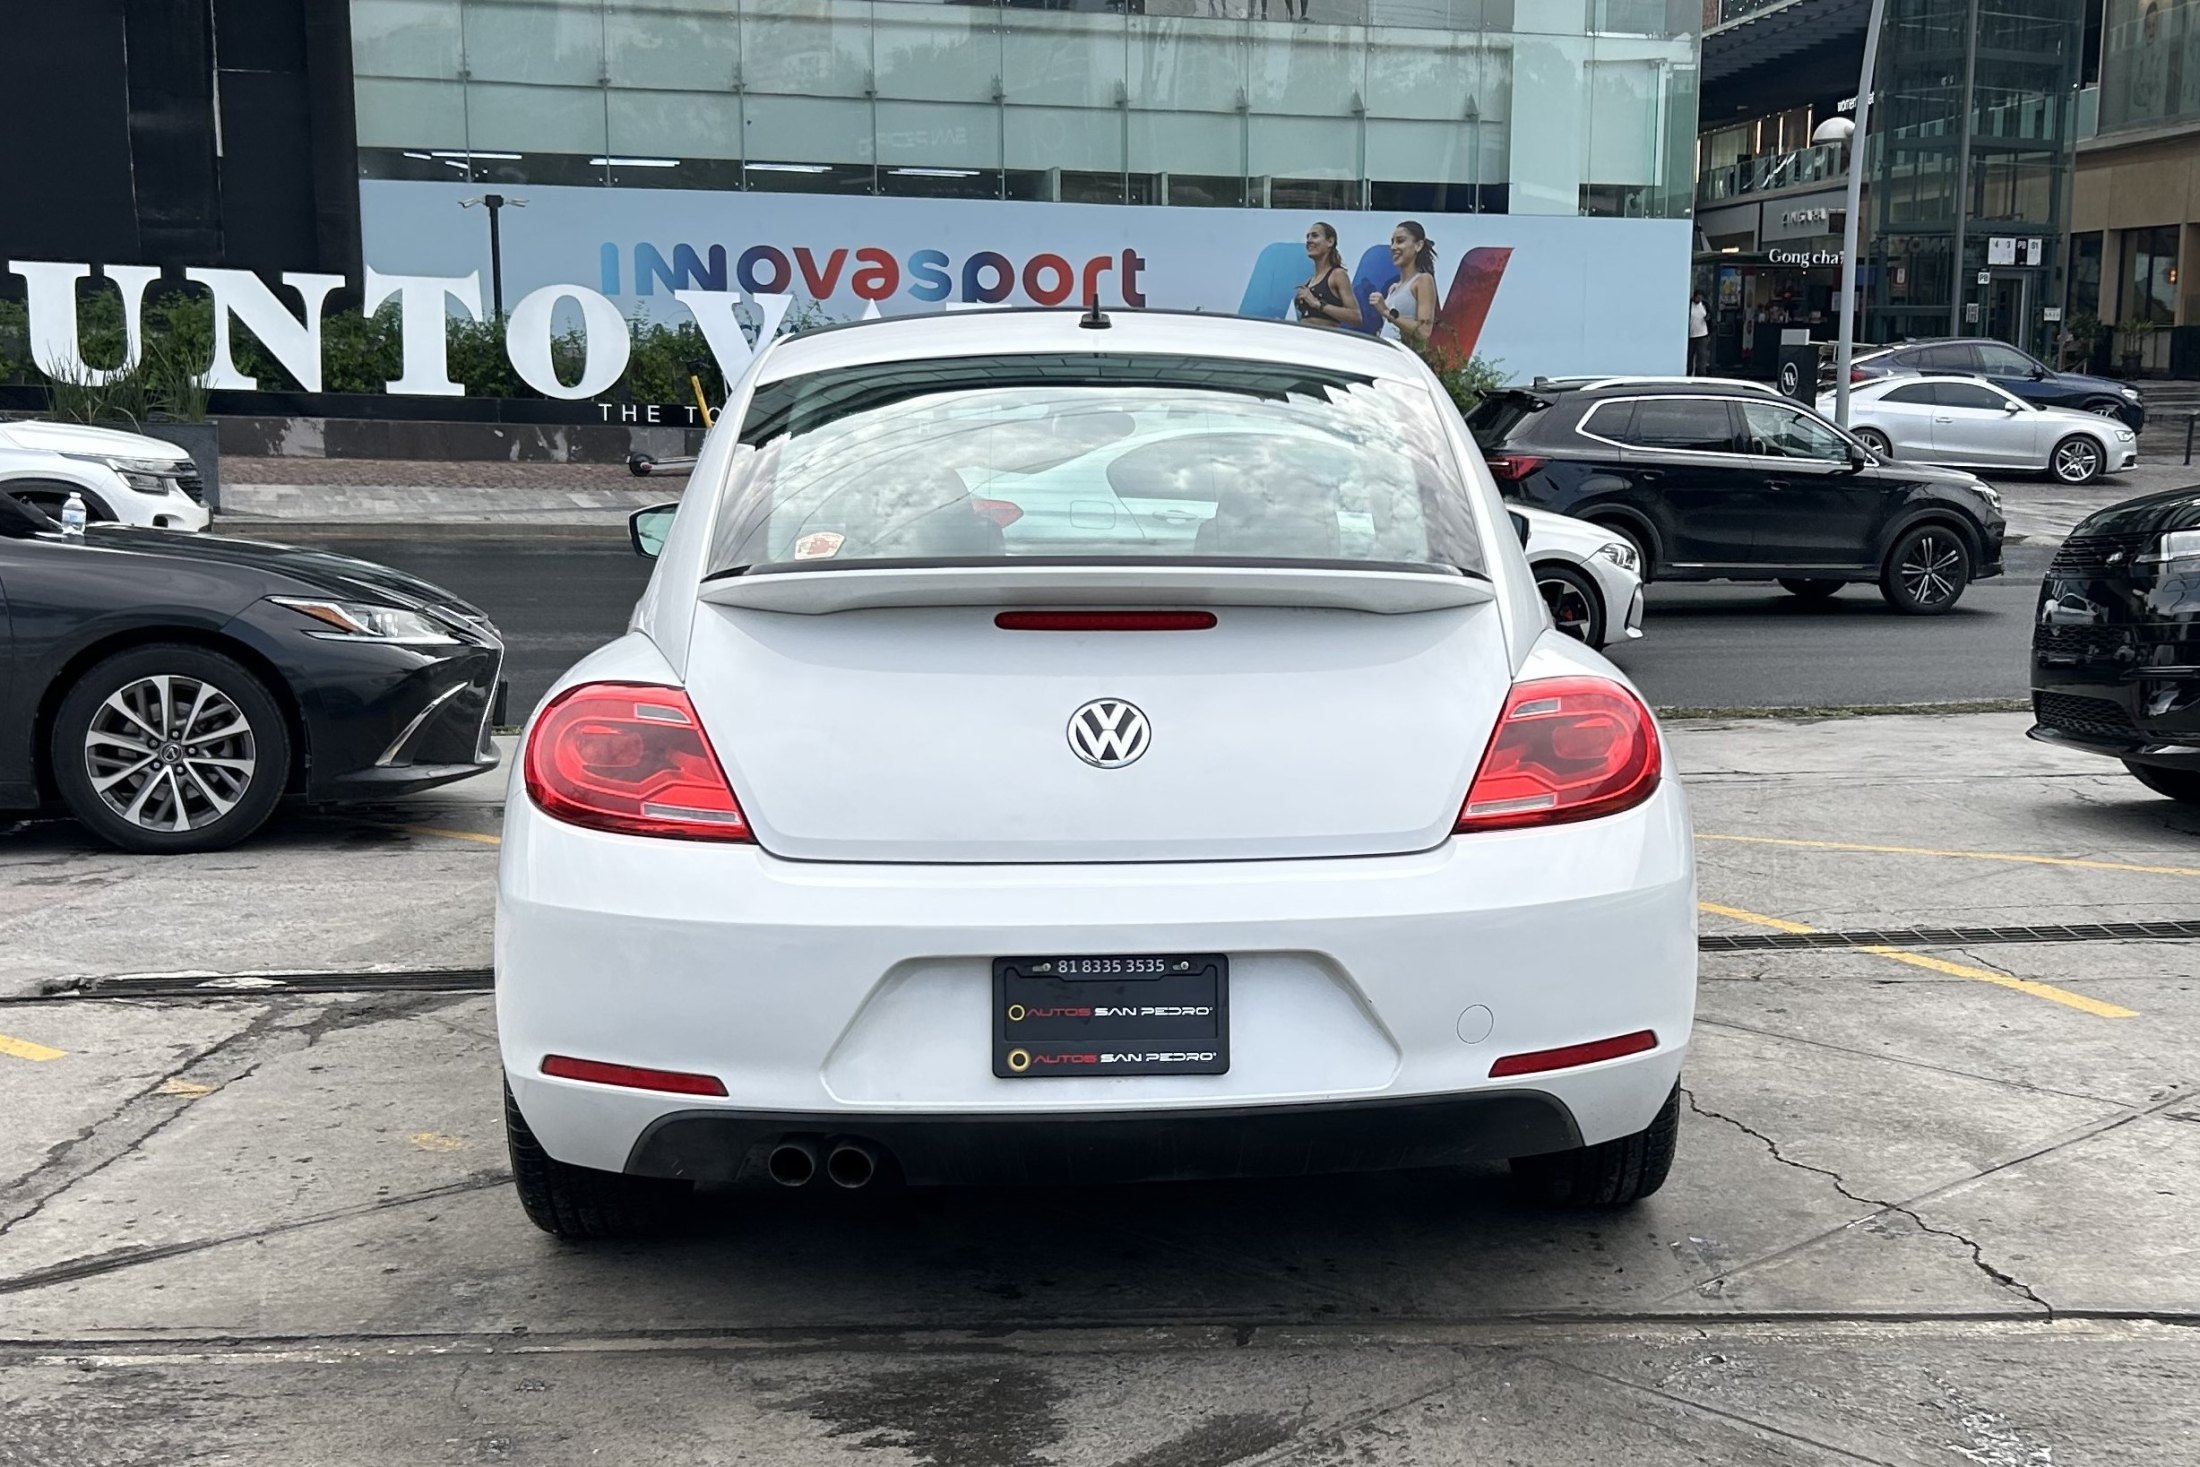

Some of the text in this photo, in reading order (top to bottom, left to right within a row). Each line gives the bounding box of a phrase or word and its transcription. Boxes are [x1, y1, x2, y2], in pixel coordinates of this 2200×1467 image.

[1769, 248, 1810, 268] Gong
[1812, 249, 1839, 264] cha
[1979, 273, 1989, 282] PB
[598, 403, 661, 423] THE
[1068, 698, 1151, 768] VW
[1057, 958, 1165, 973] 81 8335 3535
[1026, 1007, 1092, 1017] AUTOS
[1094, 1007, 1137, 1016] SAN
[1033, 1054, 1098, 1064] AUTOS
[1100, 1053, 1142, 1062] SAN
